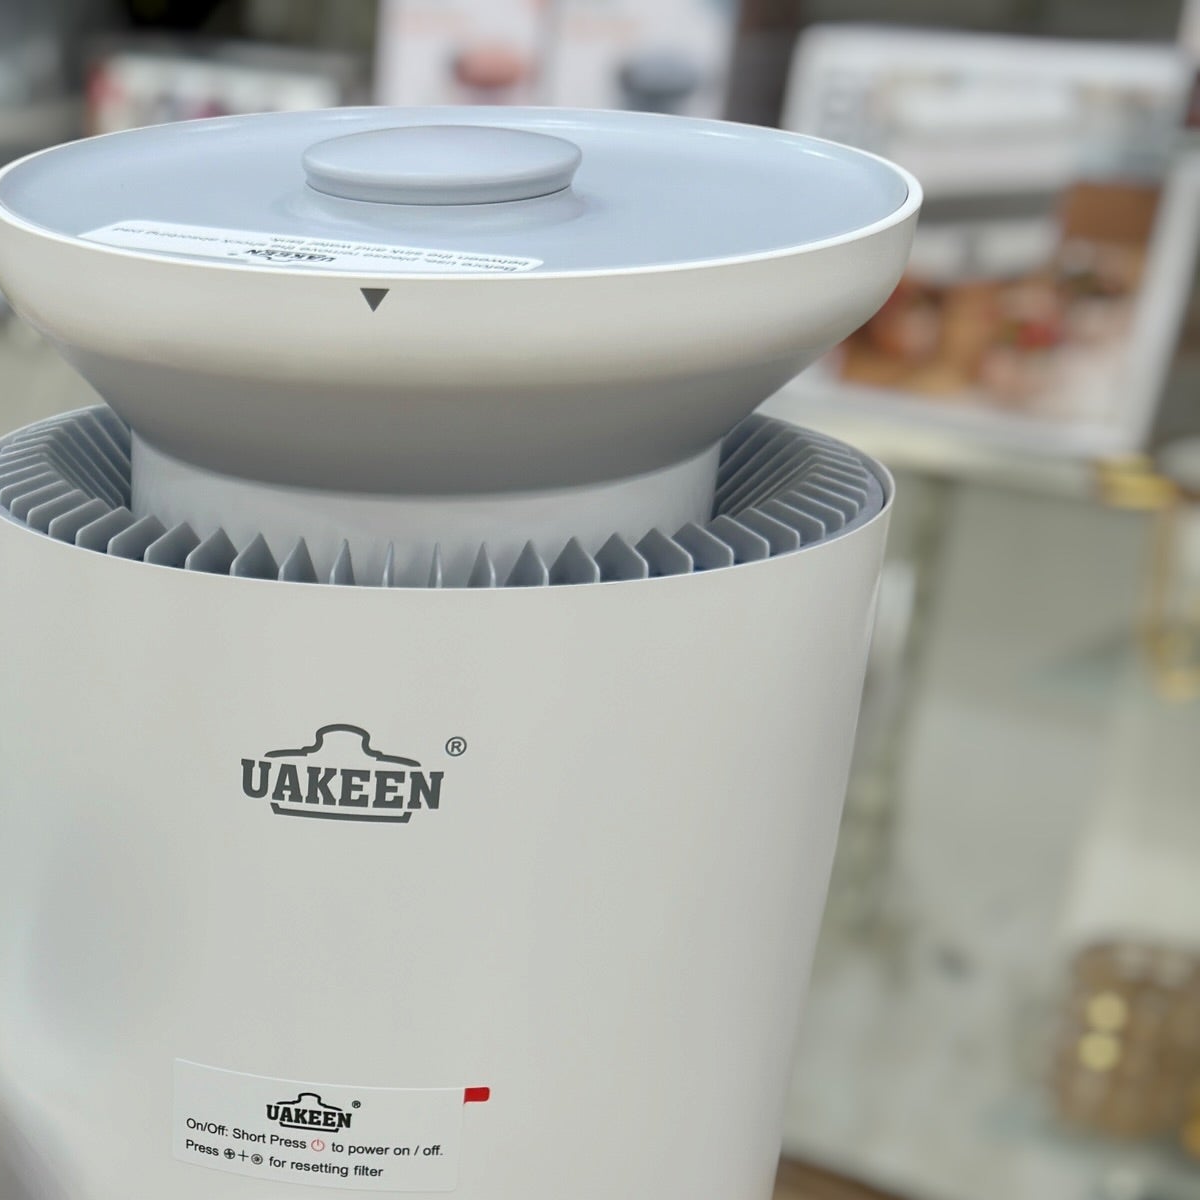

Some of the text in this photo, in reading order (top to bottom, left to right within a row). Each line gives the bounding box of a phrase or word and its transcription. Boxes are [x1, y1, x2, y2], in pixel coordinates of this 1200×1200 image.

[241, 758, 445, 810] UAKEEN
[266, 1104, 352, 1129] UAKEEN
[186, 1118, 230, 1138] On/Off:
[232, 1127, 267, 1144] Short
[270, 1134, 308, 1151] Press
[331, 1141, 345, 1154] to
[348, 1144, 389, 1157] power
[393, 1145, 411, 1157] on
[422, 1144, 445, 1157] off.
[185, 1139, 220, 1157] Press
[269, 1156, 287, 1169] for
[290, 1159, 349, 1178] resetting
[353, 1164, 385, 1178] filter
